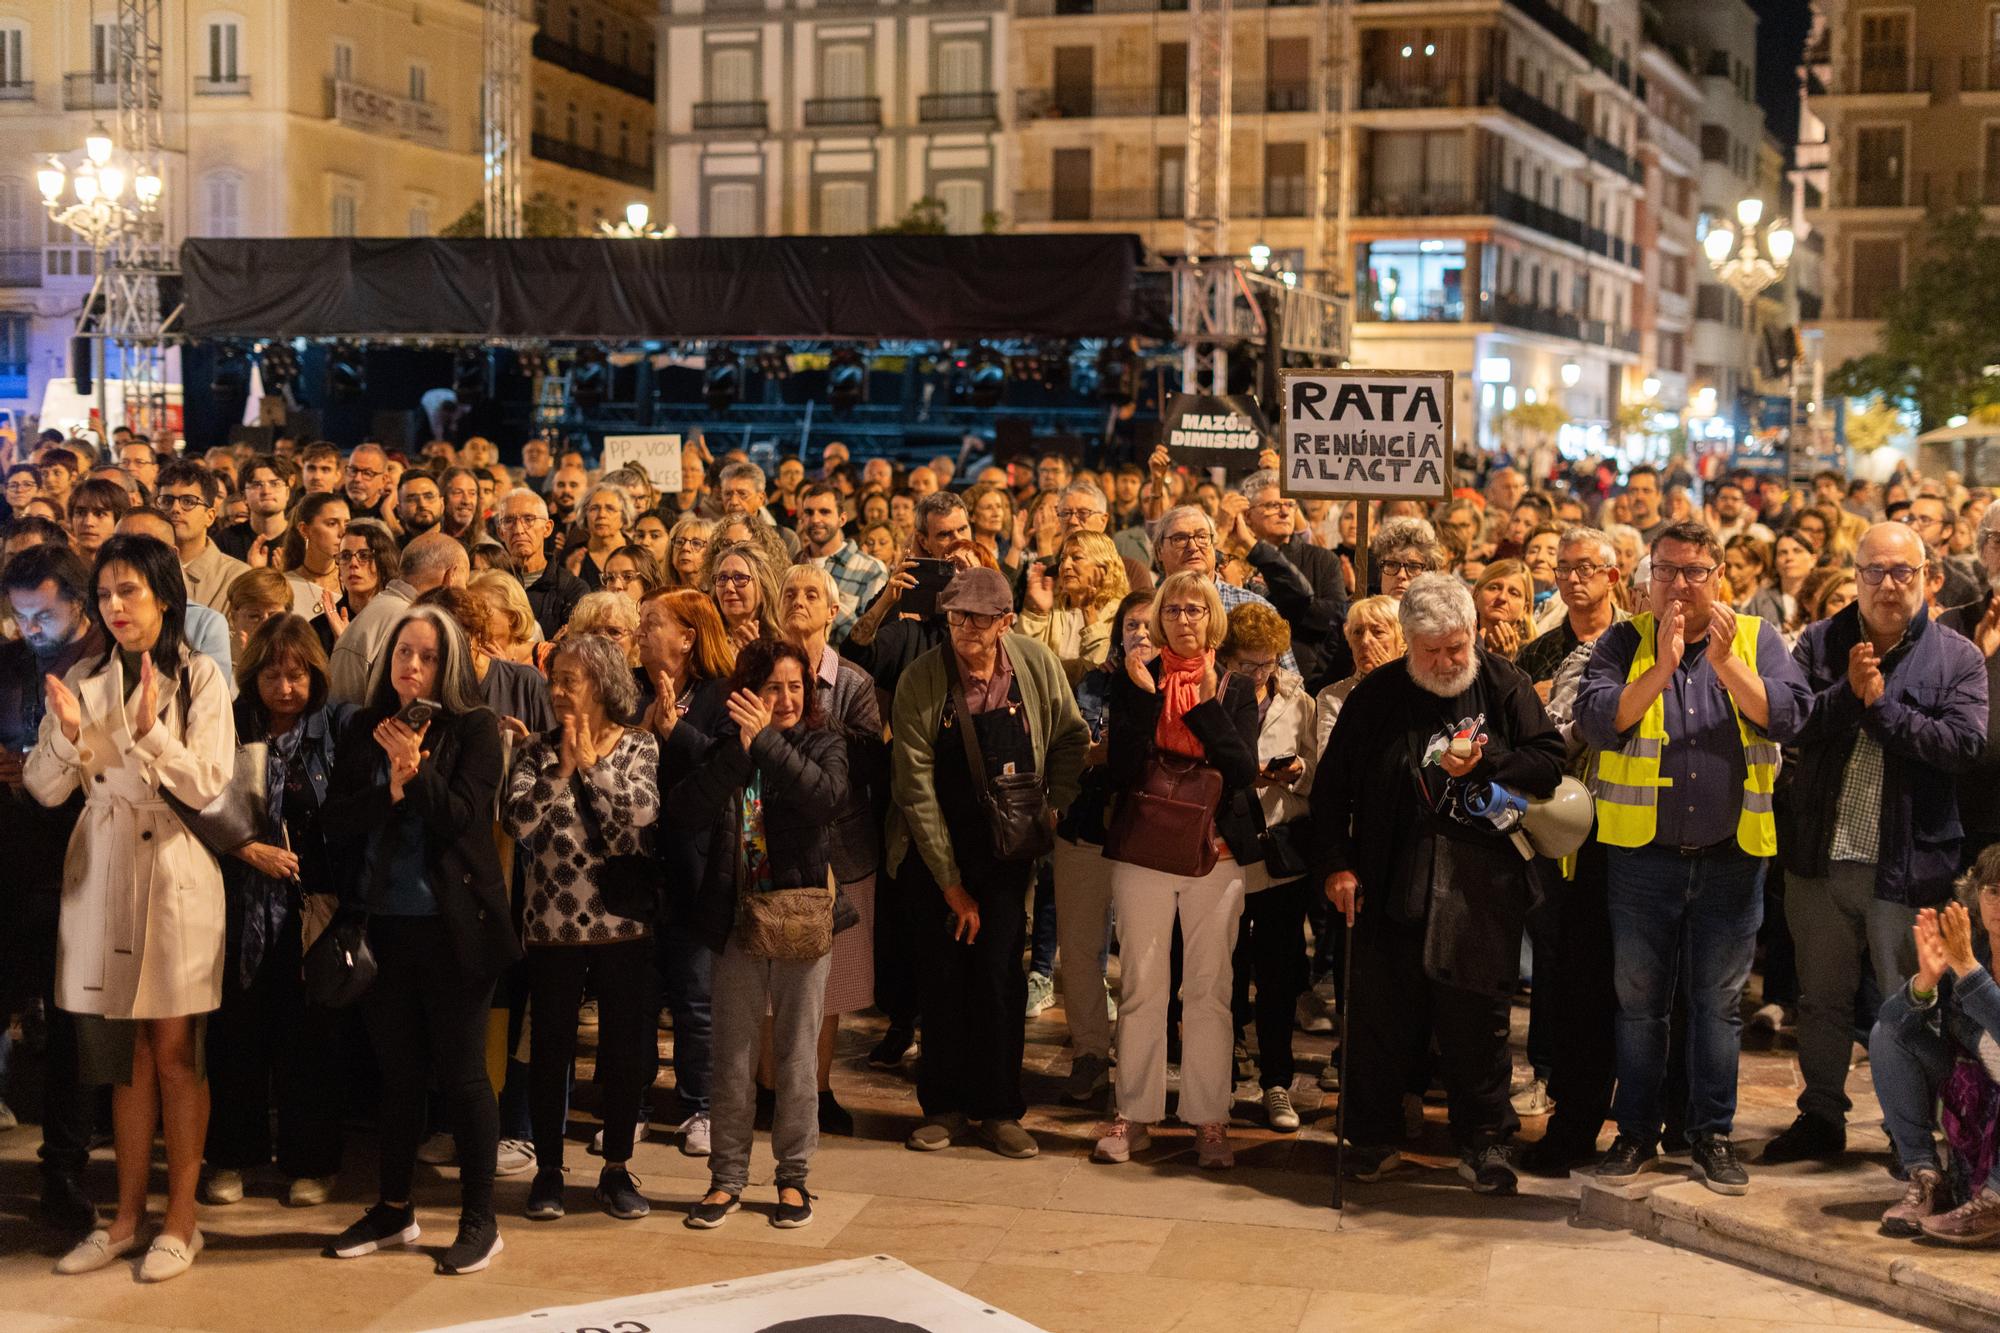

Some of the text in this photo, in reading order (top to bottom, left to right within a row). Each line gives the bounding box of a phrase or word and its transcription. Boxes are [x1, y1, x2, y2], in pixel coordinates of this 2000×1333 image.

[609, 440, 632, 459] PP
[644, 441, 676, 457] VOX
[1170, 429, 1260, 450] DIMISSIÓ
[1291, 458, 1314, 480] A
